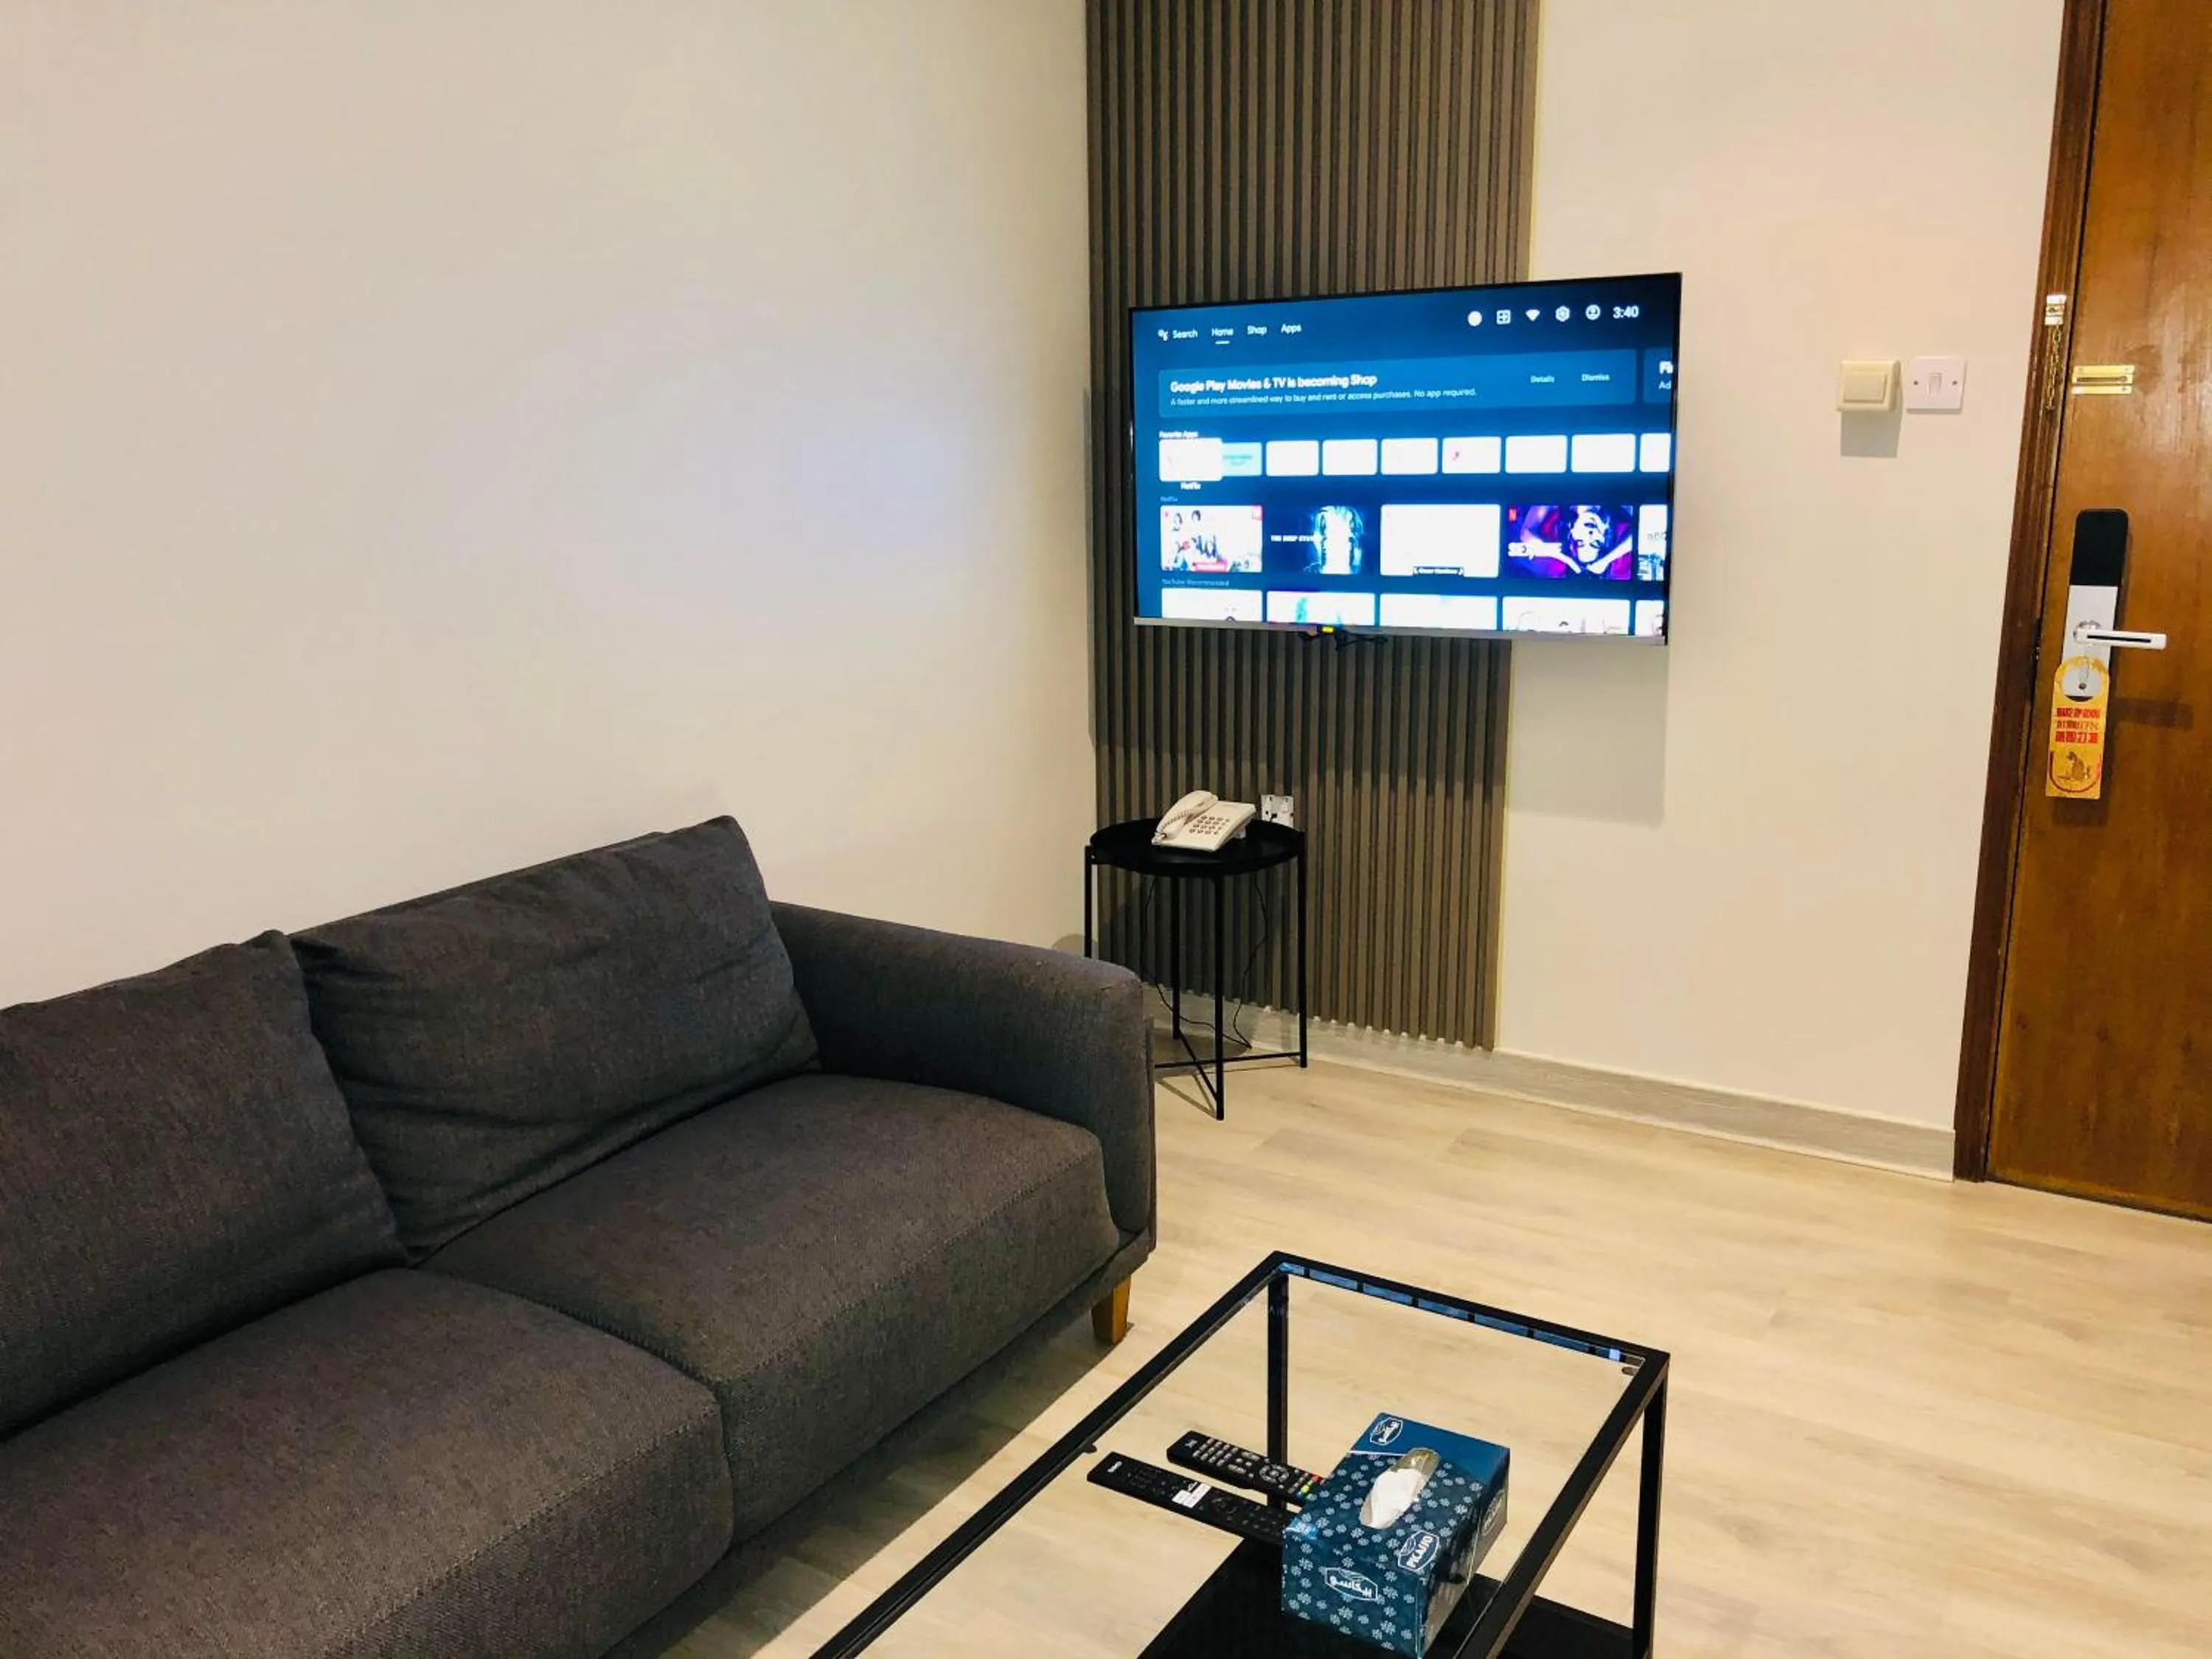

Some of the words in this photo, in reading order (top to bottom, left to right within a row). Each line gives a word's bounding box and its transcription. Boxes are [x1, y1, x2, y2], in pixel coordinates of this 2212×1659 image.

[1613, 305, 1639, 319] 3:40
[1172, 328, 1198, 338] Search
[1211, 327, 1234, 337] Home
[1247, 325, 1267, 335] Shop
[1281, 323, 1301, 334] Apps
[1530, 375, 1555, 383] Details
[1582, 373, 1610, 381] Dismiss
[1170, 380, 1205, 394] Google
[1206, 380, 1226, 393] Play
[1227, 378, 1262, 390] Movies
[1273, 377, 1287, 388] TV
[1287, 377, 1296, 388] is
[1297, 375, 1349, 389] becoming
[1350, 373, 1377, 387] Shop
[1197, 397, 1210, 405] and
[1229, 395, 1268, 404] streamlined
[1293, 394, 1306, 403] buy
[1307, 393, 1321, 401] and
[1322, 393, 1337, 401] rent
[1373, 390, 1411, 400] purchases.
[1413, 389, 1425, 397] No
[1427, 391, 1441, 399] app
[1442, 388, 1477, 397] required.
[1180, 481, 1201, 490] Netflix
